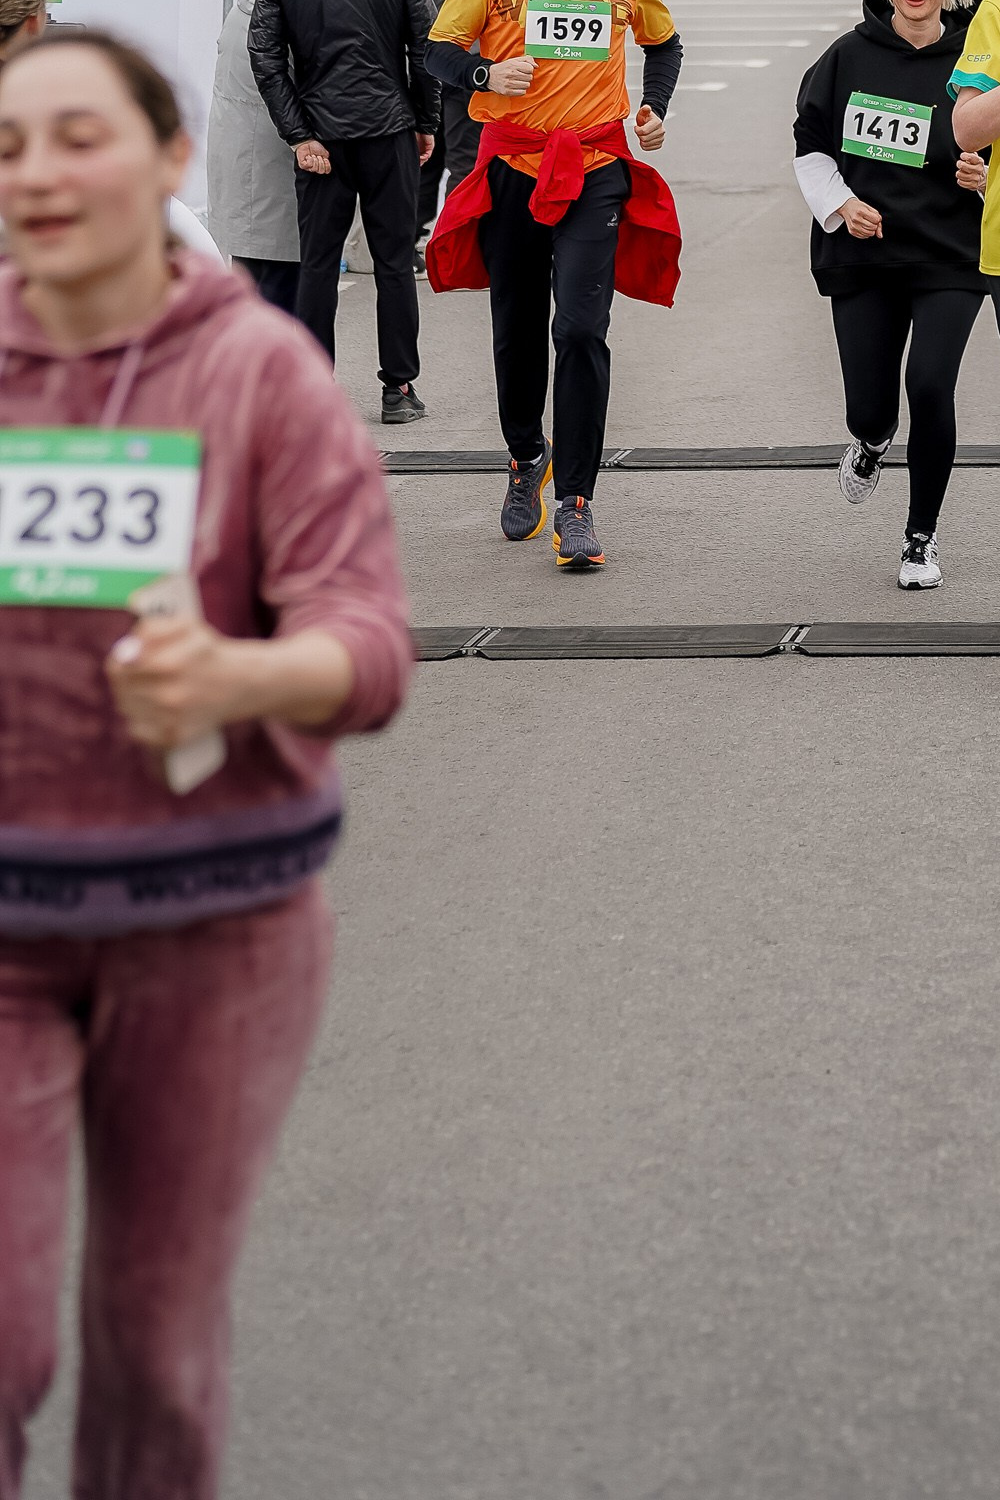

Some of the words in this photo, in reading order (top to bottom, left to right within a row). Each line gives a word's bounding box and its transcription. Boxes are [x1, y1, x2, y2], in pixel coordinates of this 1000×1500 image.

[536, 16, 603, 42] 1599
[966, 53, 991, 63] СБЕР
[853, 112, 921, 146] 1413
[0, 483, 160, 547] 233
